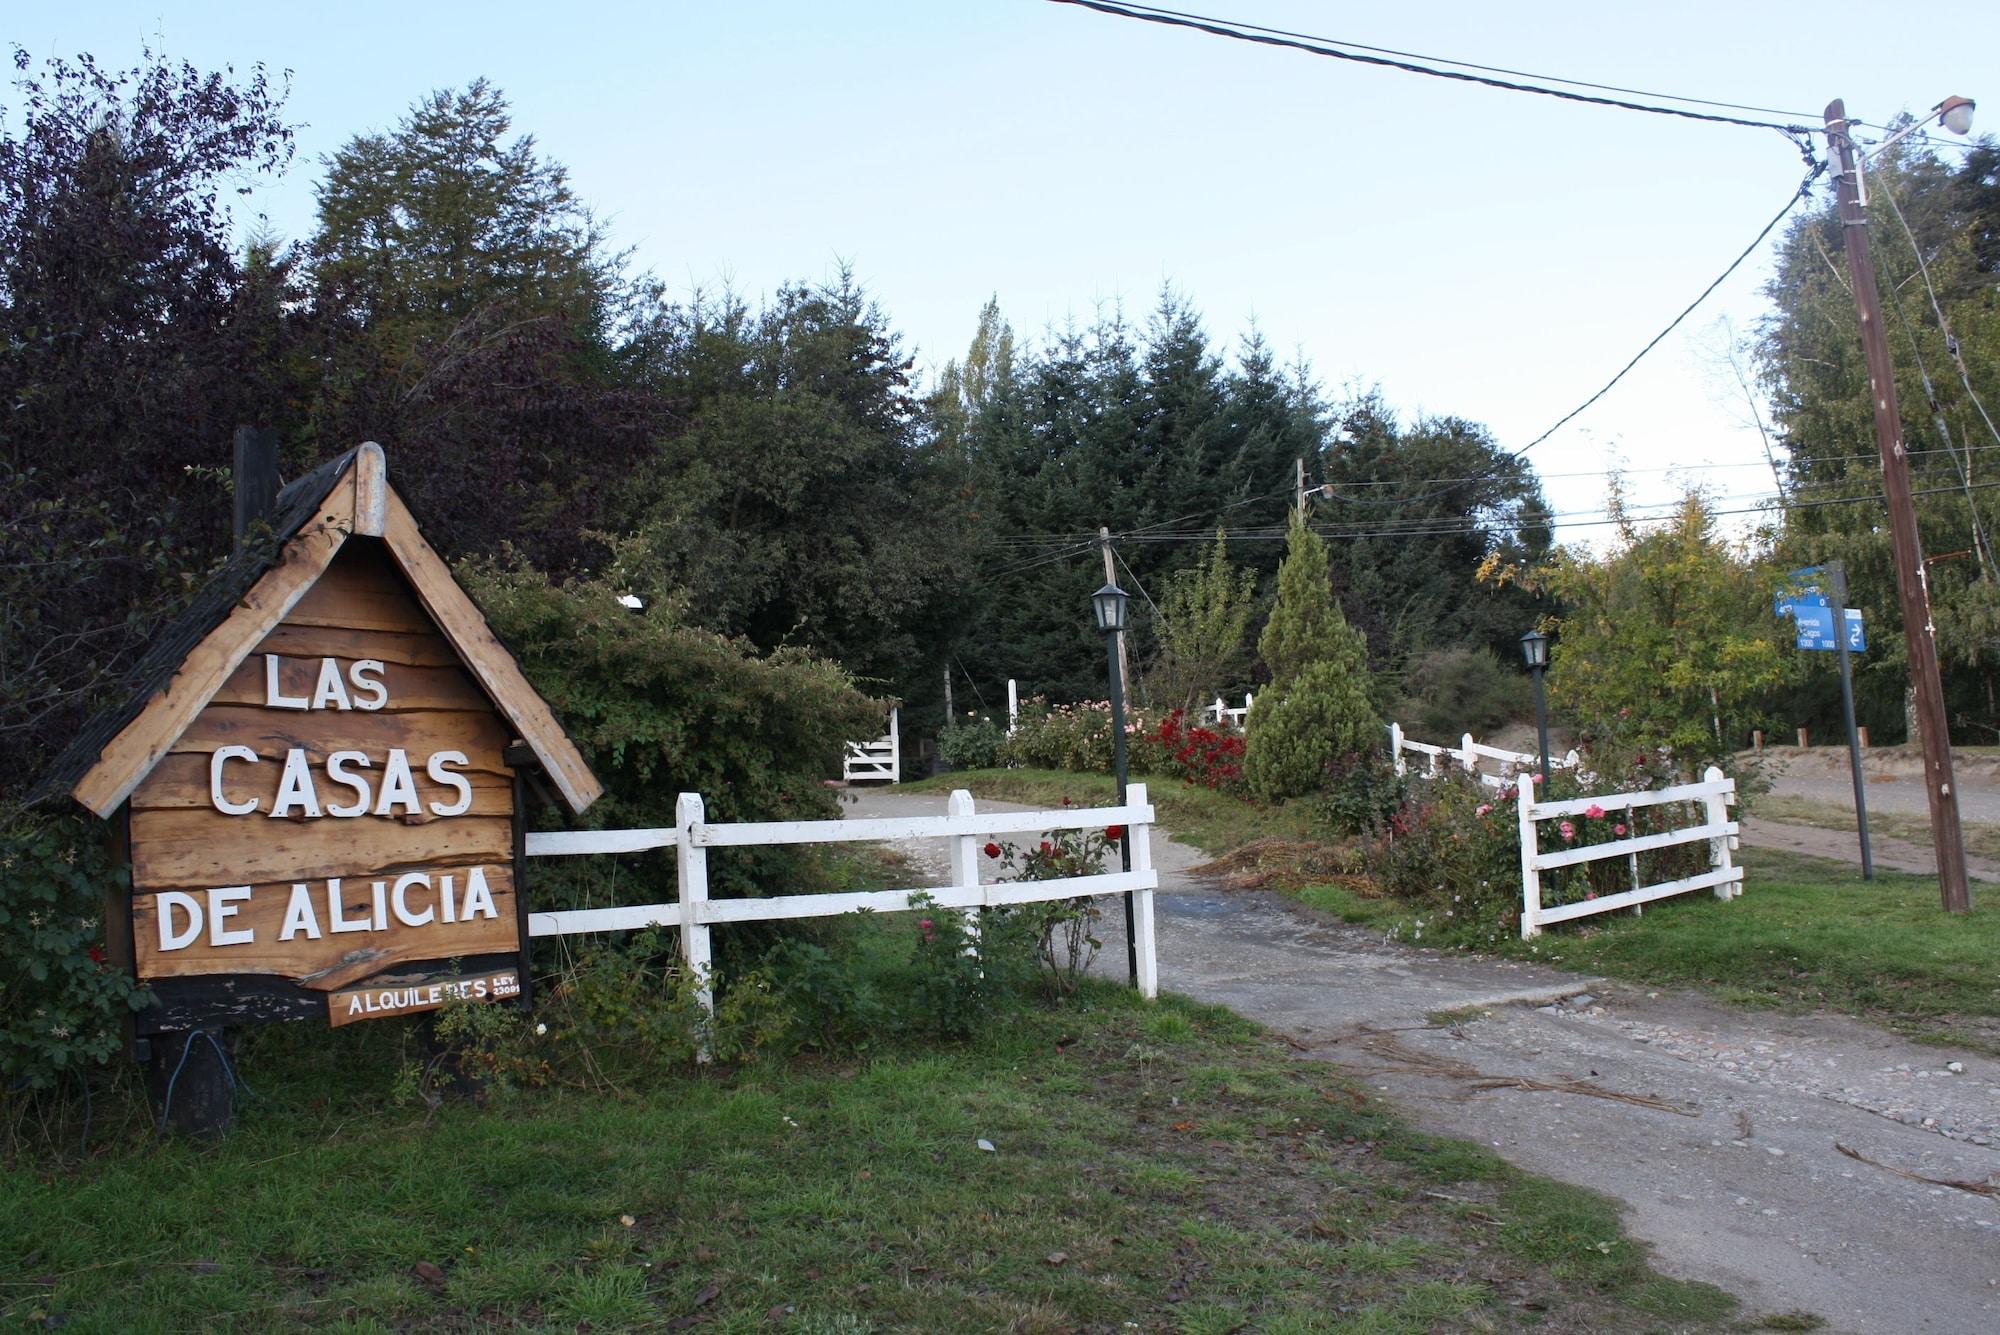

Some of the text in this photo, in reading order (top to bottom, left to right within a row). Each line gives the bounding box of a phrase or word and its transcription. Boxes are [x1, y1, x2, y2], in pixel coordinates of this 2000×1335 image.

[266, 654, 388, 710] LAS
[211, 745, 472, 817] CASAS
[156, 866, 498, 951] DE ALICIA
[493, 976, 515, 986] LEY
